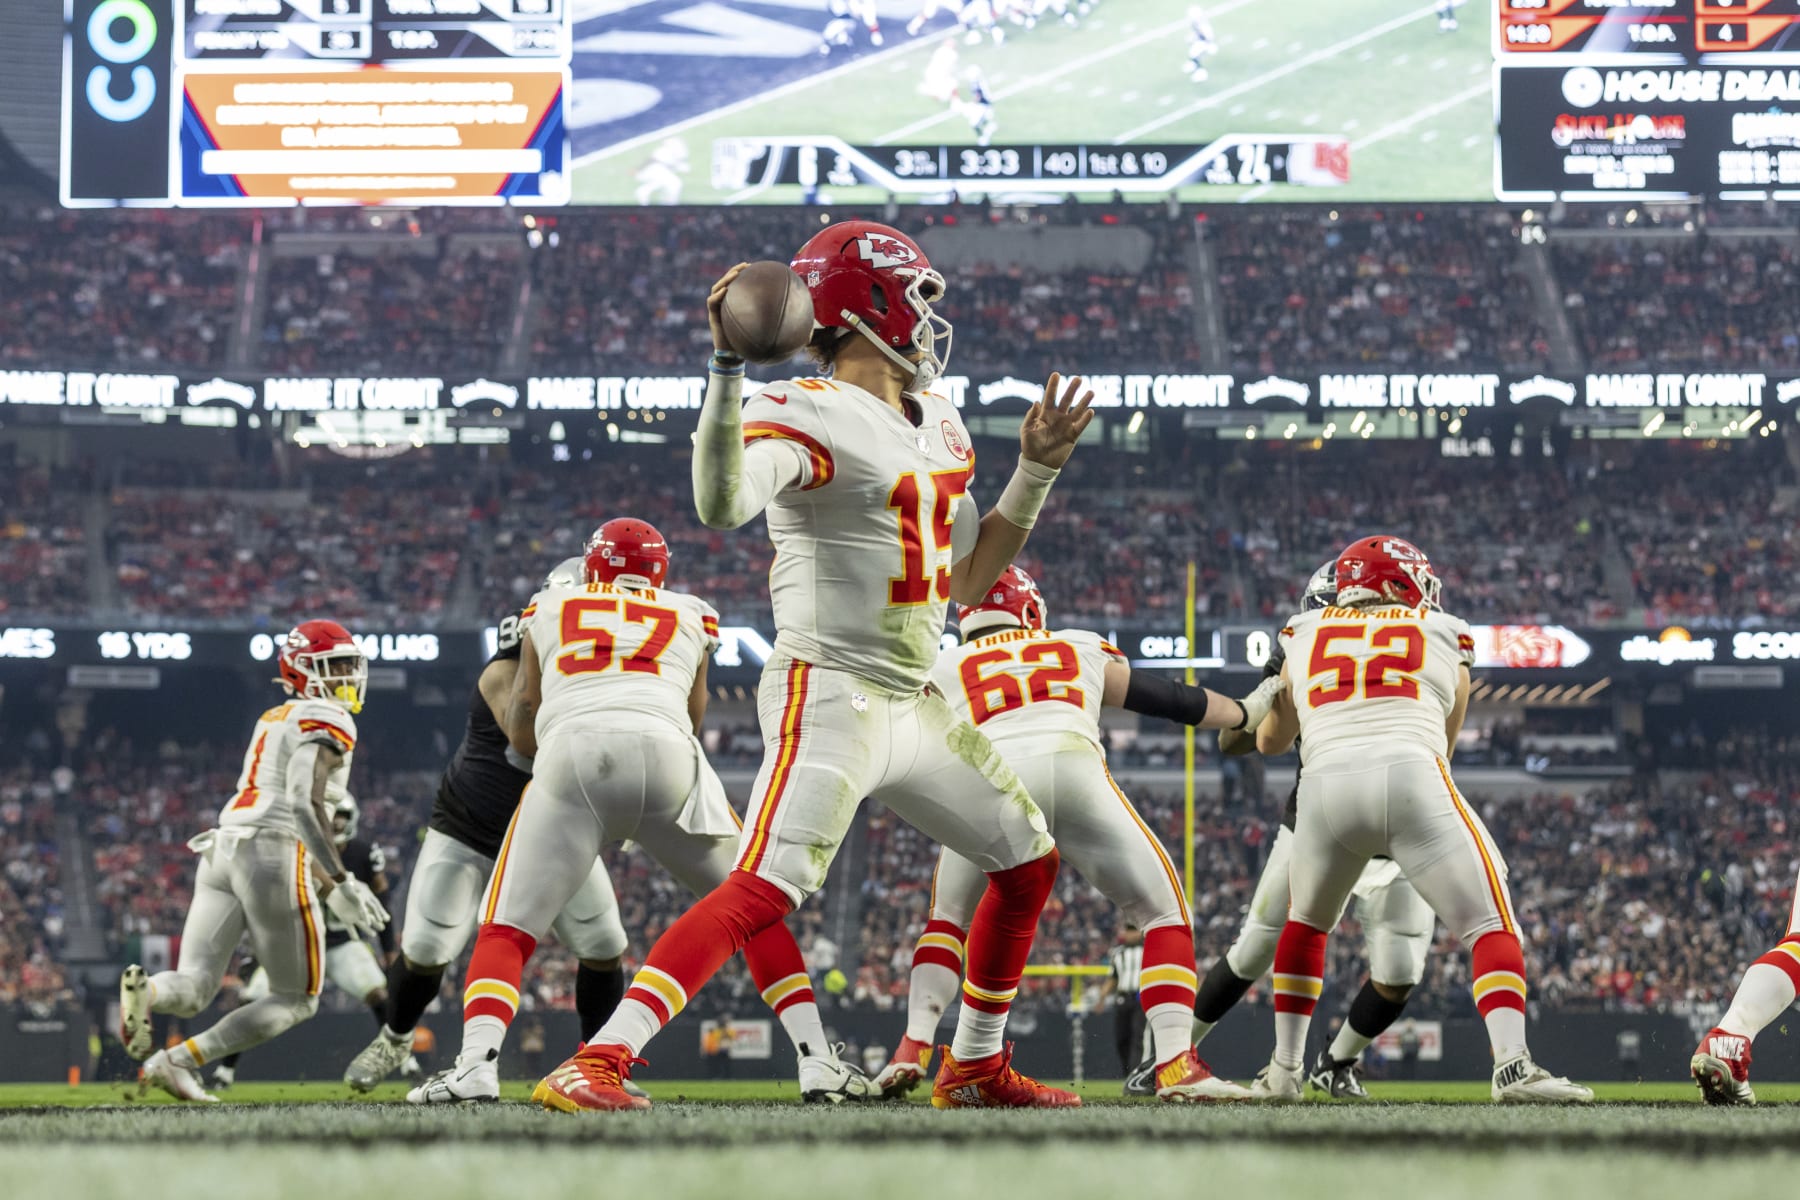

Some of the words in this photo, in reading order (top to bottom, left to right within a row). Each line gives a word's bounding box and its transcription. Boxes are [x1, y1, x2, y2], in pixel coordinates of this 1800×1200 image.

[1603, 70, 1722, 102] HOUSE
[959, 149, 1020, 175] 3:33
[1044, 152, 1076, 175] 40
[1142, 152, 1167, 175] 10
[66, 373, 97, 405] IT
[333, 378, 363, 410] IT
[597, 377, 626, 409] IT
[1124, 375, 1154, 407] IT
[1389, 375, 1418, 407] IT
[1656, 374, 1685, 406] IT
[132, 632, 192, 660] YDS
[381, 634, 439, 660] LNG
[556, 597, 679, 677] 57
[1307, 624, 1426, 710] 52
[956, 640, 1085, 728] 62
[1709, 1036, 1746, 1062] NIKE
[1158, 1055, 1192, 1088] NIKE
[1495, 1060, 1528, 1089] NIKE
